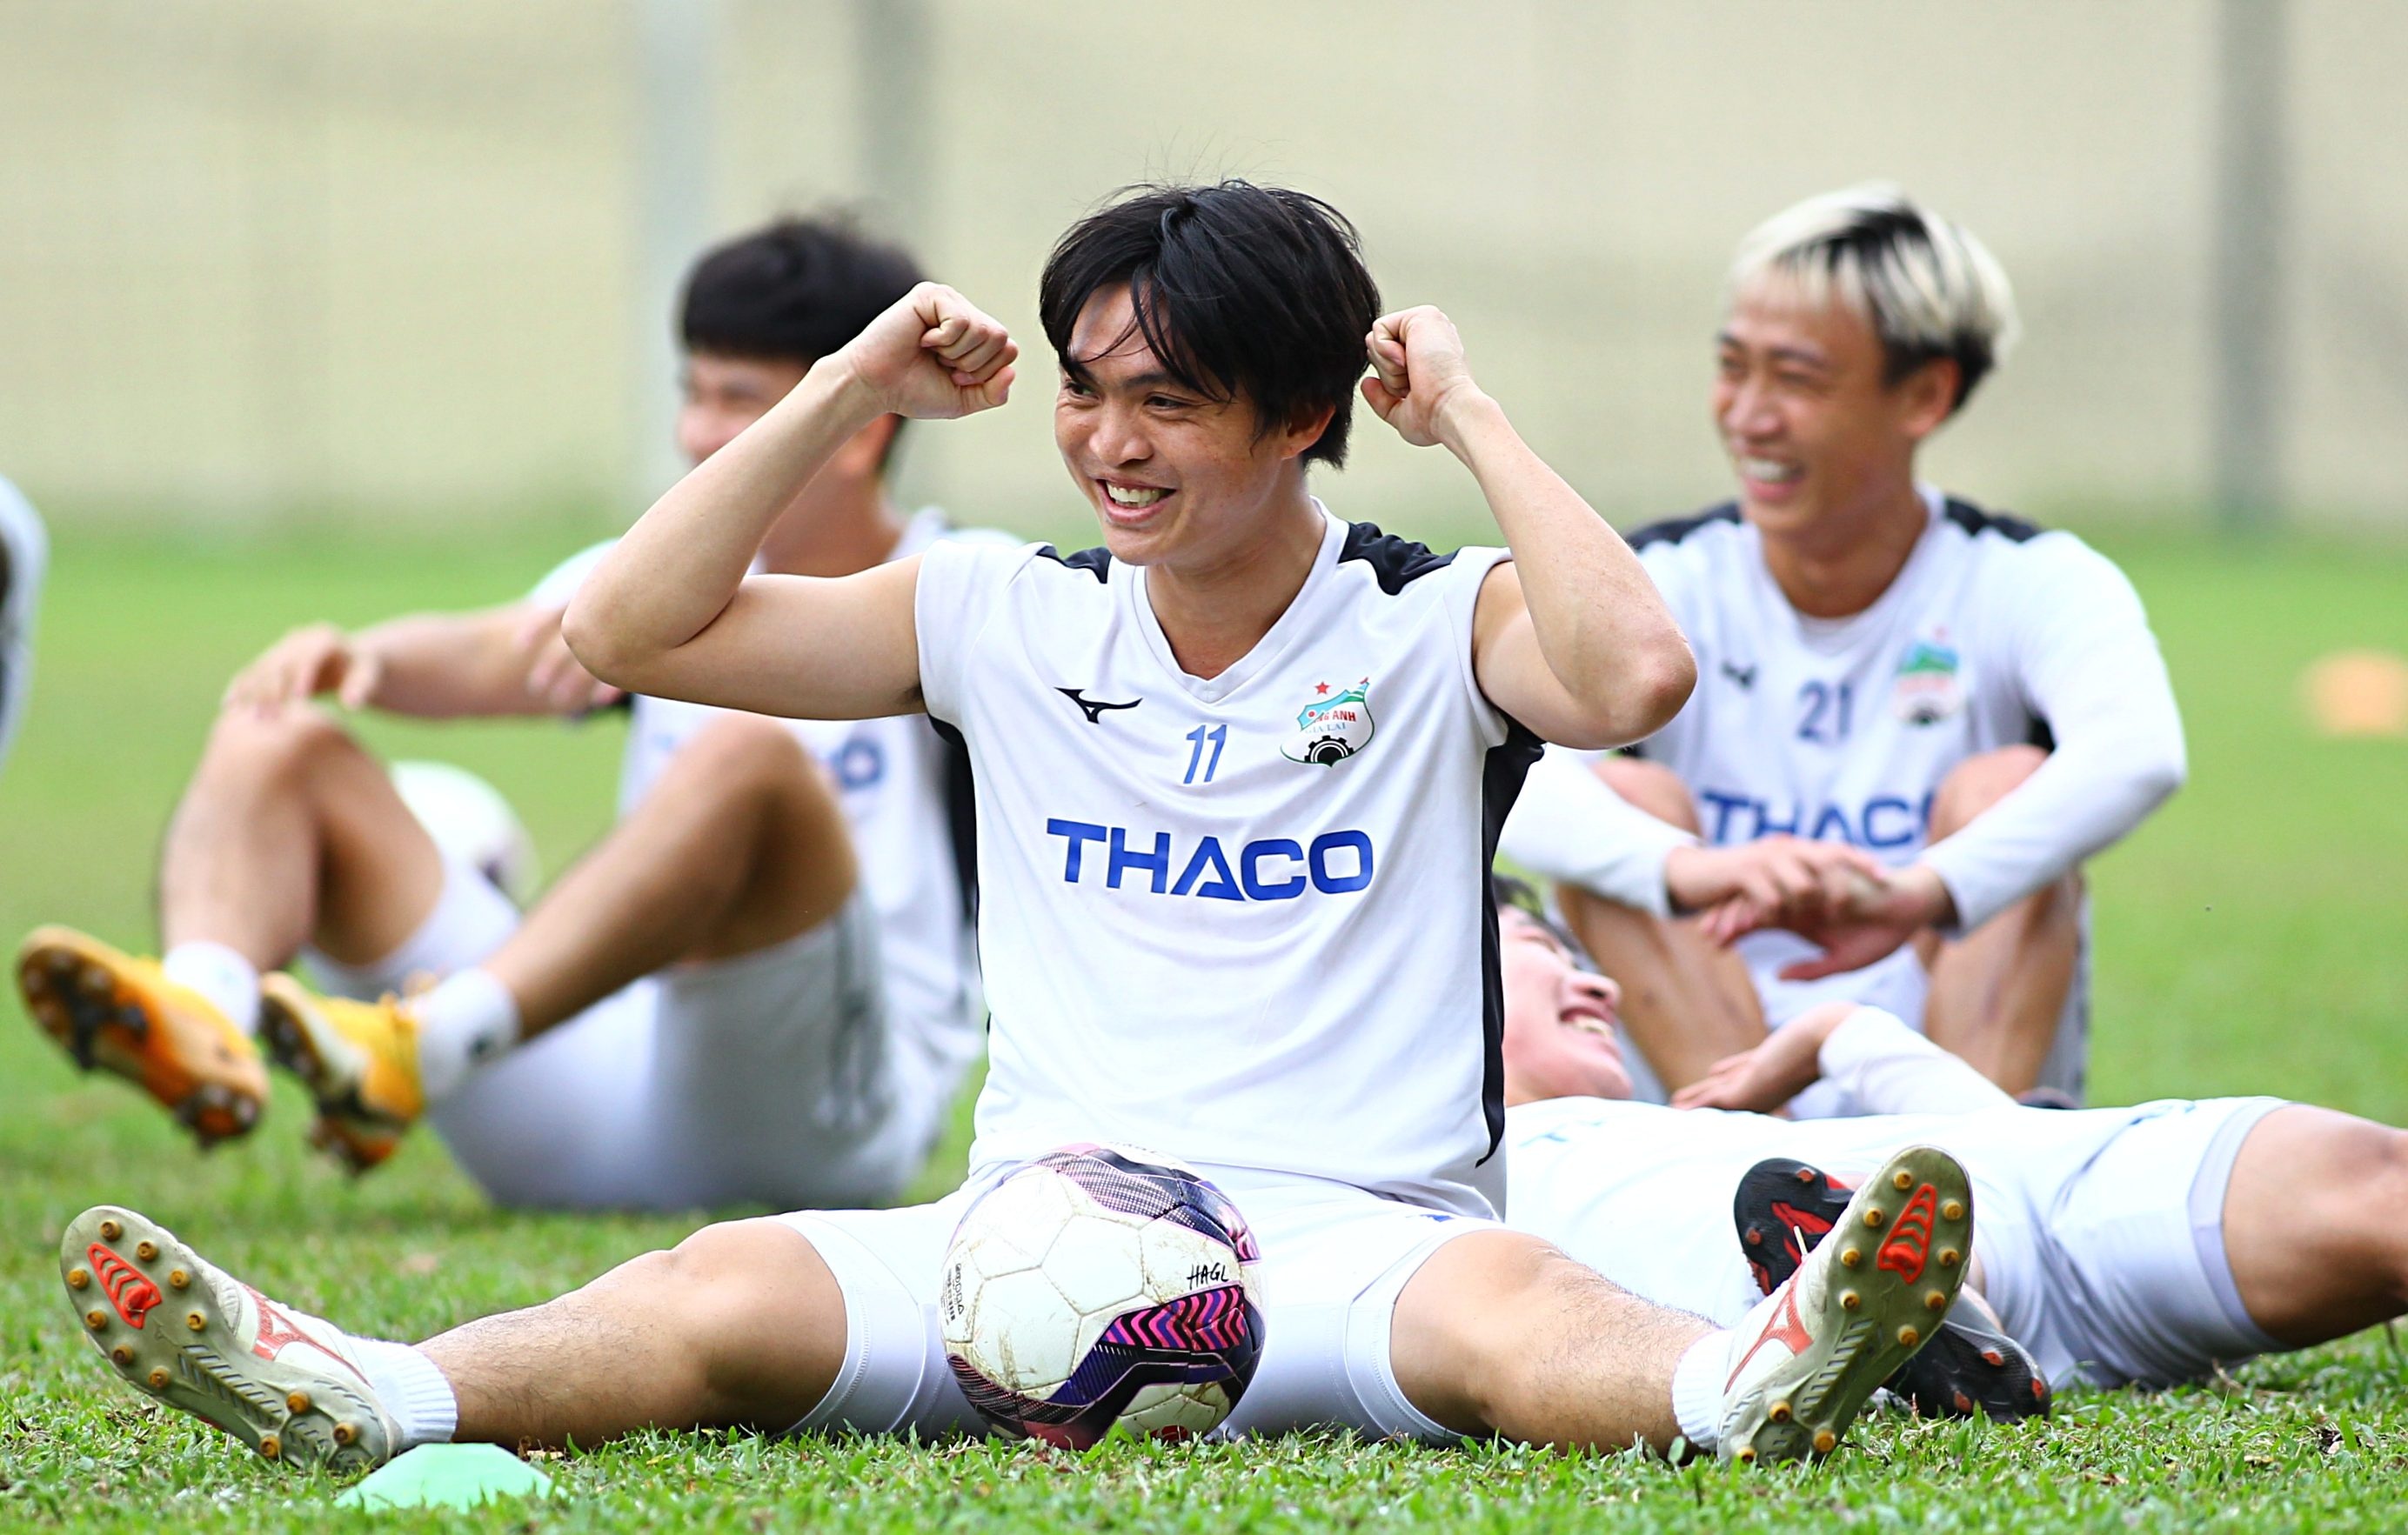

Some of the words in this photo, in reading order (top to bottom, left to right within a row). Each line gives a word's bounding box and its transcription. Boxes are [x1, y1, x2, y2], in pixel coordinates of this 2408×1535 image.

[1332, 710, 1356, 722] ANH
[1797, 678, 1852, 743] 21
[1182, 724, 1227, 784] 11
[1701, 789, 1935, 849] THAC
[1046, 818, 1375, 902] THACO
[1186, 1261, 1229, 1291] HAGL
